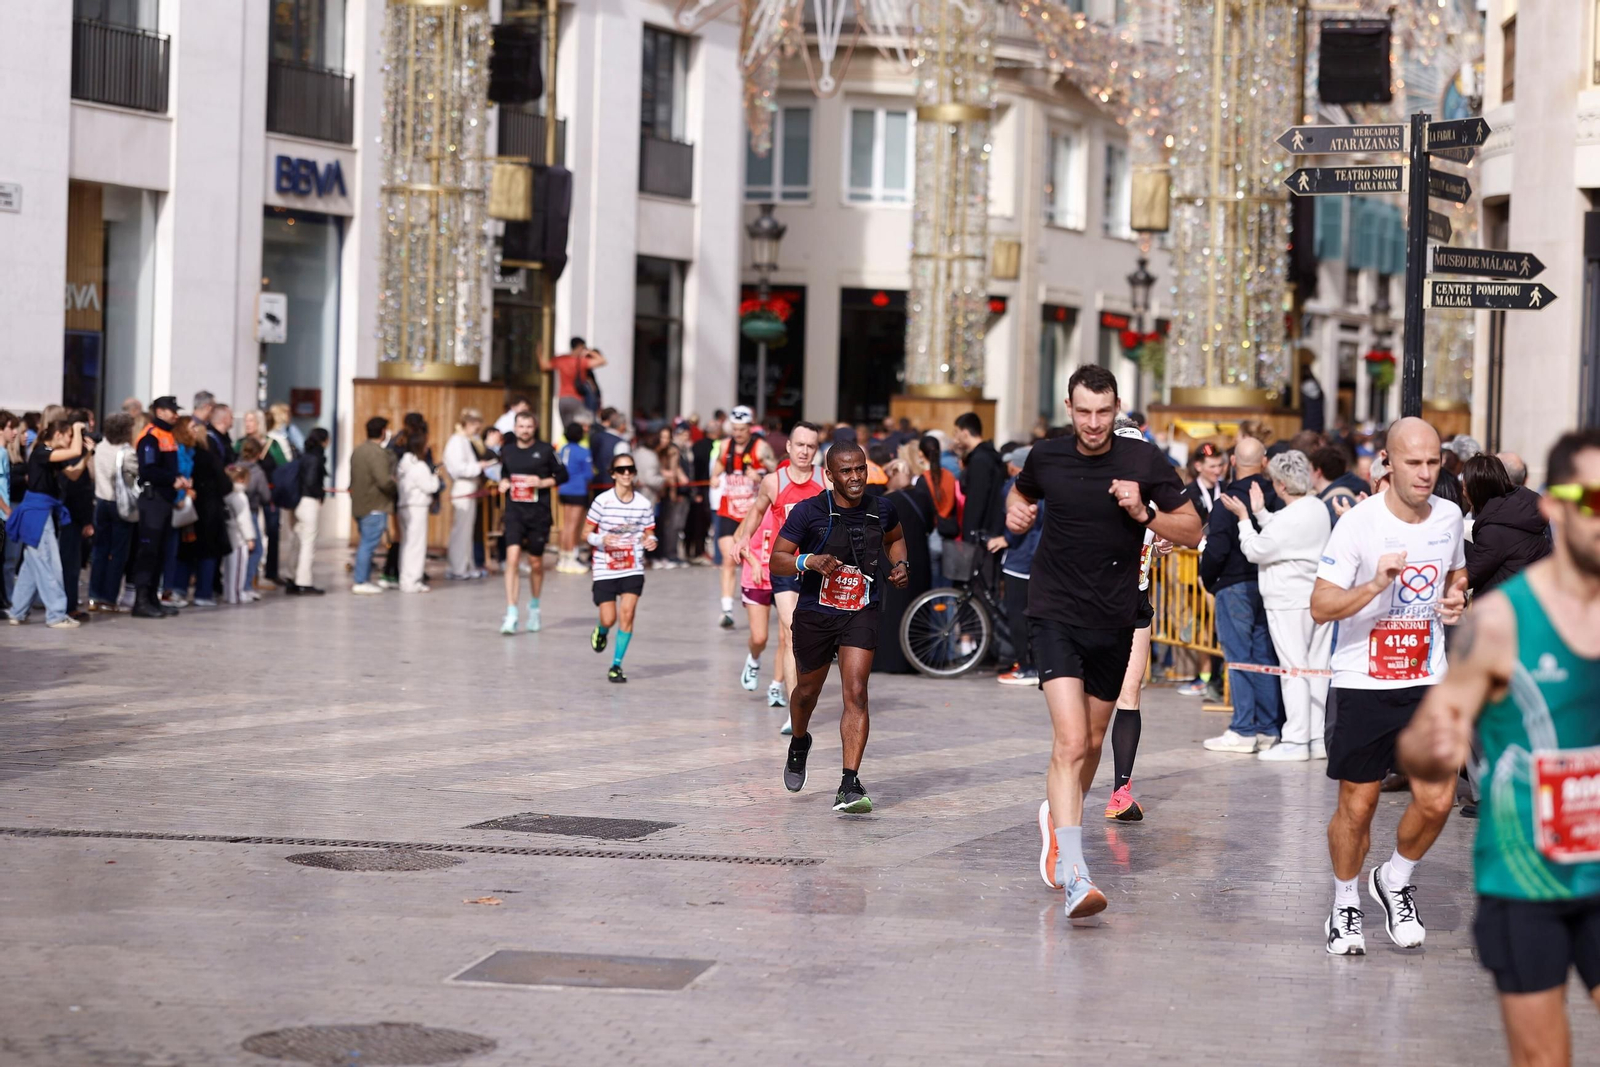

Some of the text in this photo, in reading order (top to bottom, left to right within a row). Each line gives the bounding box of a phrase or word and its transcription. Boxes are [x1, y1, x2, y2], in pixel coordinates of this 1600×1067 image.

[1352, 127, 1400, 137] MERCADO DE
[1429, 131, 1437, 143] LA
[1329, 137, 1400, 151] ATARAZANAS
[276, 155, 347, 198] BBVA
[1335, 169, 1399, 181] TEATRO SOHO
[1354, 181, 1398, 191] CAIXA BANK
[1434, 253, 1518, 272] MUSEO DE MÁLAGA
[1435, 284, 1521, 296] CENTRE POMPIDOU
[1435, 293, 1472, 307] MÁLAGA
[835, 575, 859, 586] 4495
[1387, 620, 1428, 630] GENERALI
[1384, 634, 1418, 648] 4146
